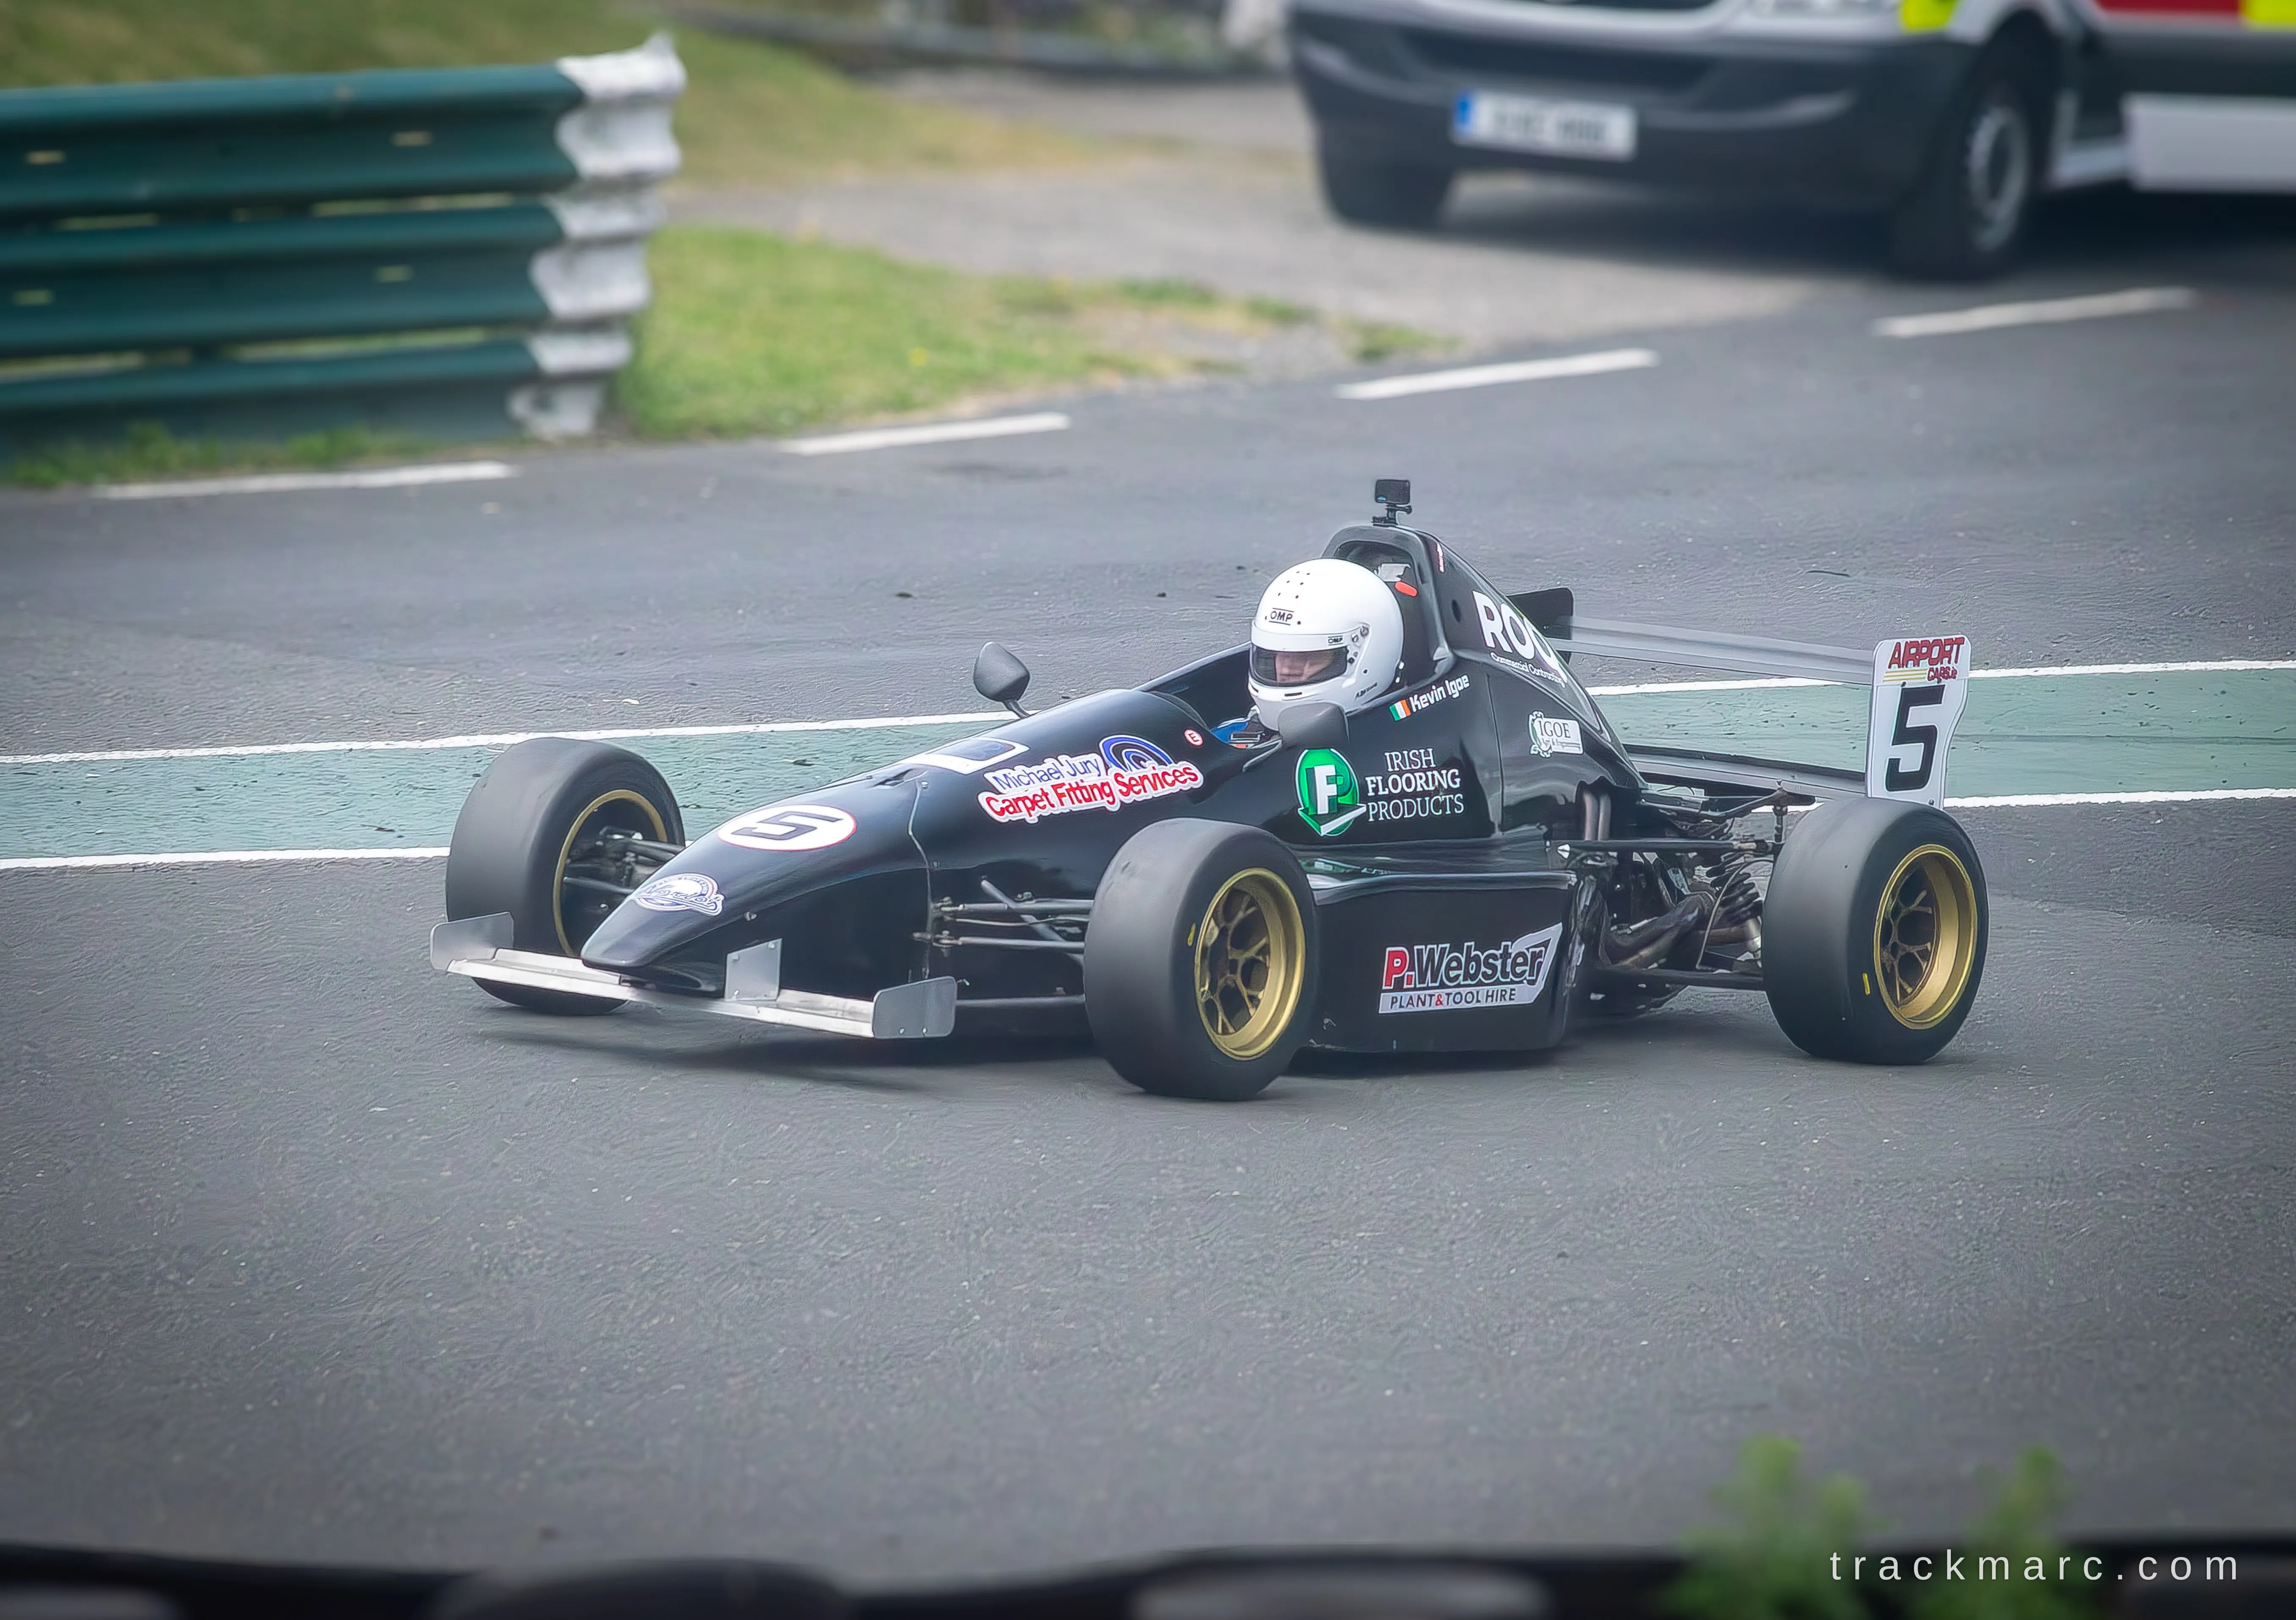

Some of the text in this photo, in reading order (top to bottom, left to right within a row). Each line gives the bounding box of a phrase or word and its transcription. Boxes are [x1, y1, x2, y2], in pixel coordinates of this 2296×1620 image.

[1270, 611, 1293, 622] OMP
[1888, 637, 1965, 669] AIRPORT
[1409, 675, 1469, 712] Kevin Igoe
[1188, 733, 1199, 742] E
[1537, 720, 1571, 738] IGOE
[1886, 684, 1945, 792] 5
[993, 757, 1101, 790] Michael Jury
[1384, 748, 1436, 772] IRISH
[986, 765, 1199, 817] Carpet Fitting Services
[1365, 769, 1461, 796] FLOORING
[1367, 794, 1464, 821] PRODUCTS
[731, 811, 844, 841] 5
[1485, 988, 1516, 1003] HIRE
